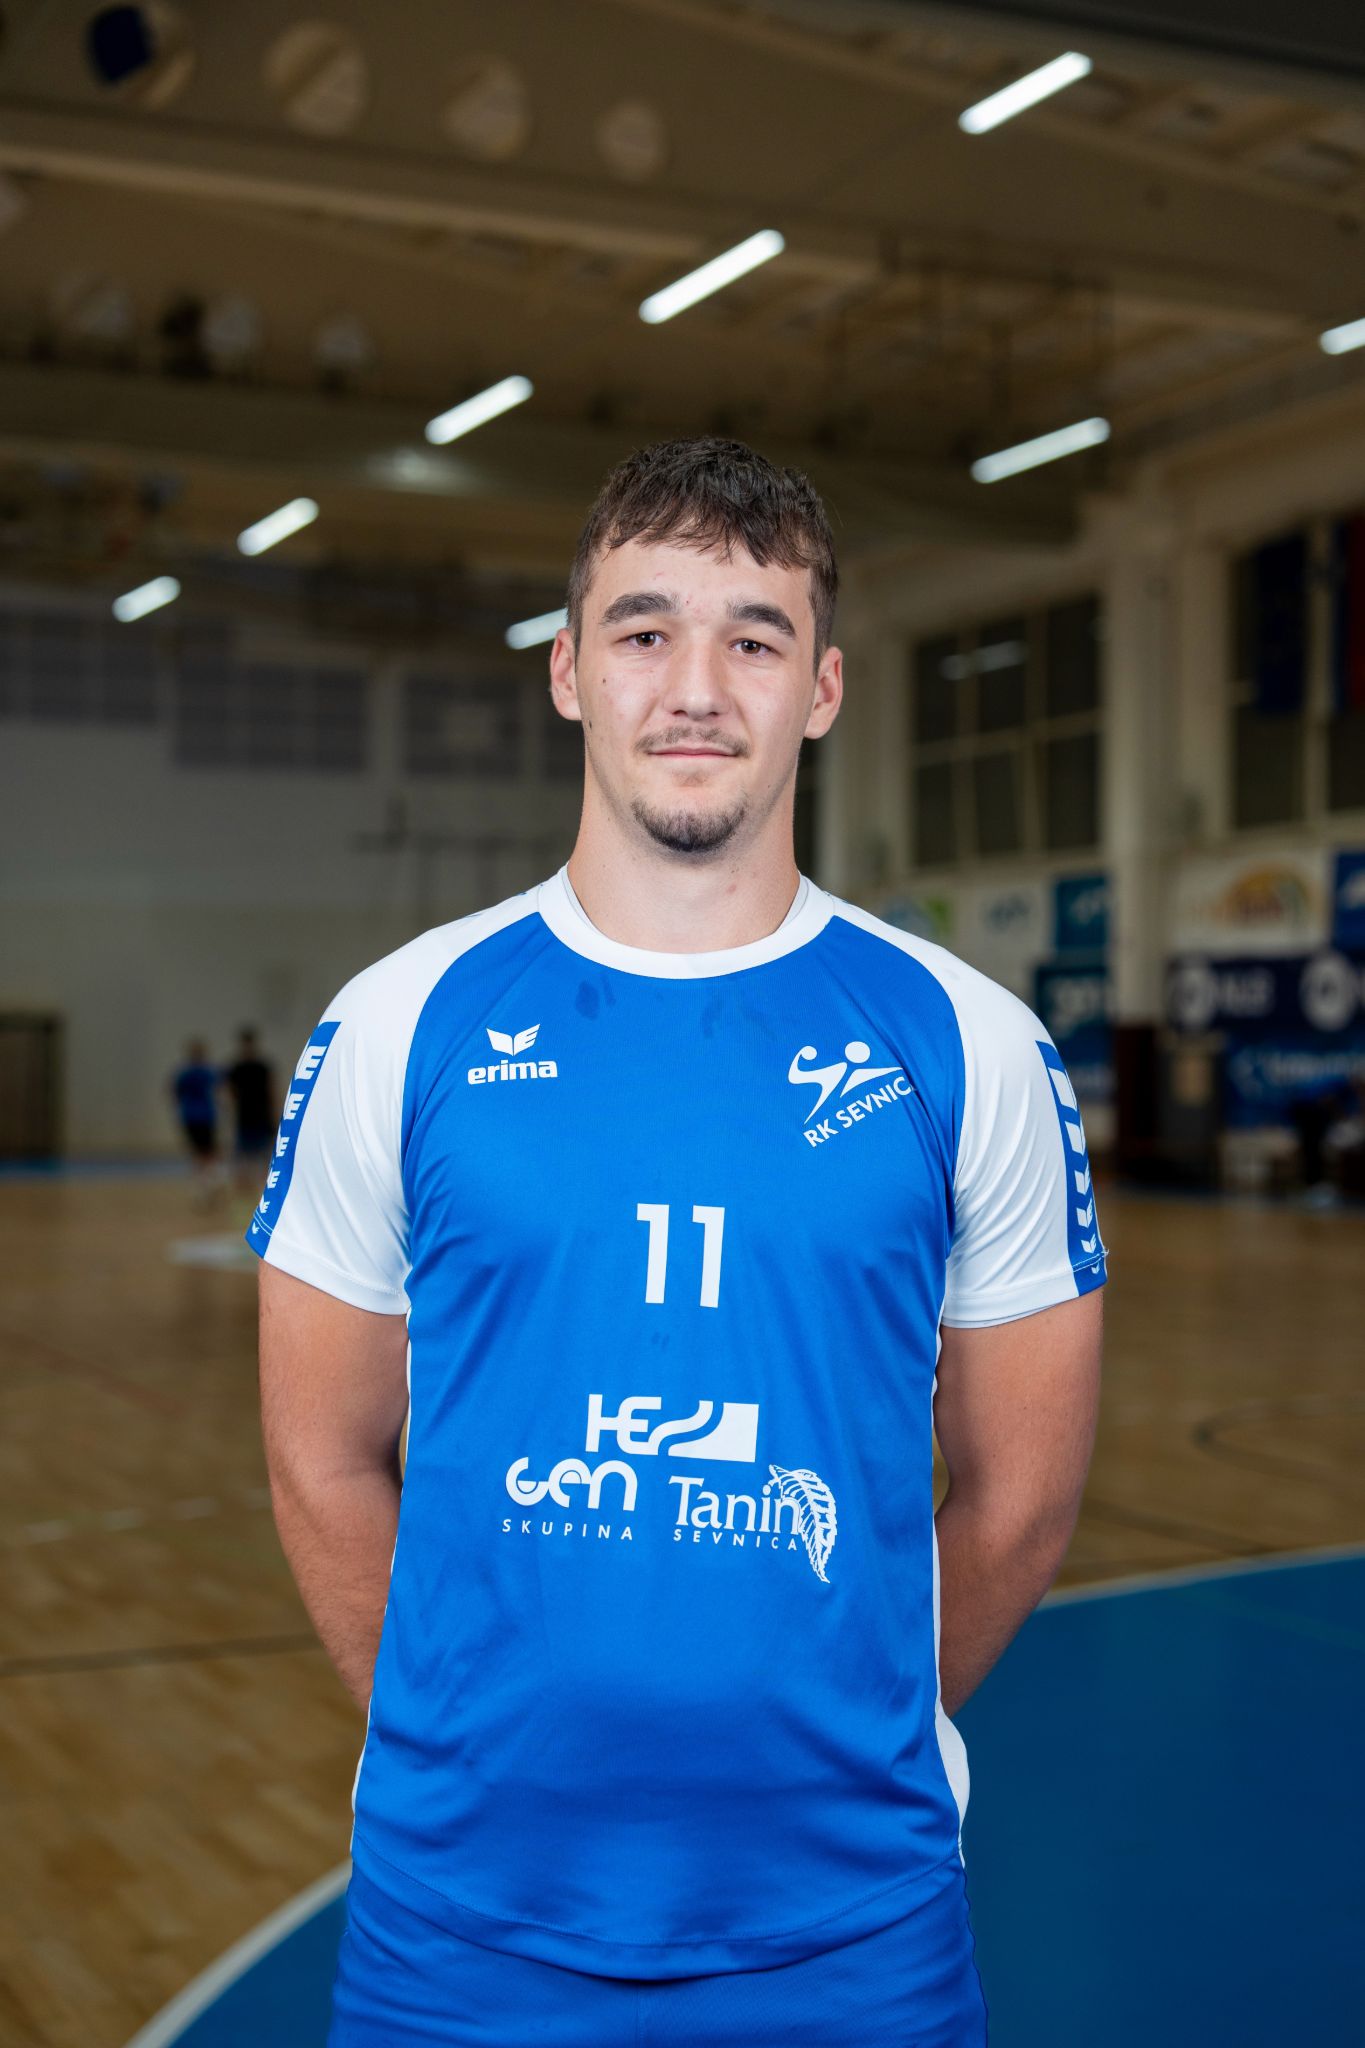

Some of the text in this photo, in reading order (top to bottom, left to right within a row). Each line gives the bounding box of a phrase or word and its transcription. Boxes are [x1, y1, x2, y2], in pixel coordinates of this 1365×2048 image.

[468, 1060, 558, 1085] erima
[803, 1077, 916, 1147] RK SEVNIC
[637, 1203, 725, 1308] 11
[669, 1476, 801, 1535] Tanin
[502, 1518, 633, 1540] SKUPINA
[674, 1529, 797, 1551] SEVNICA
